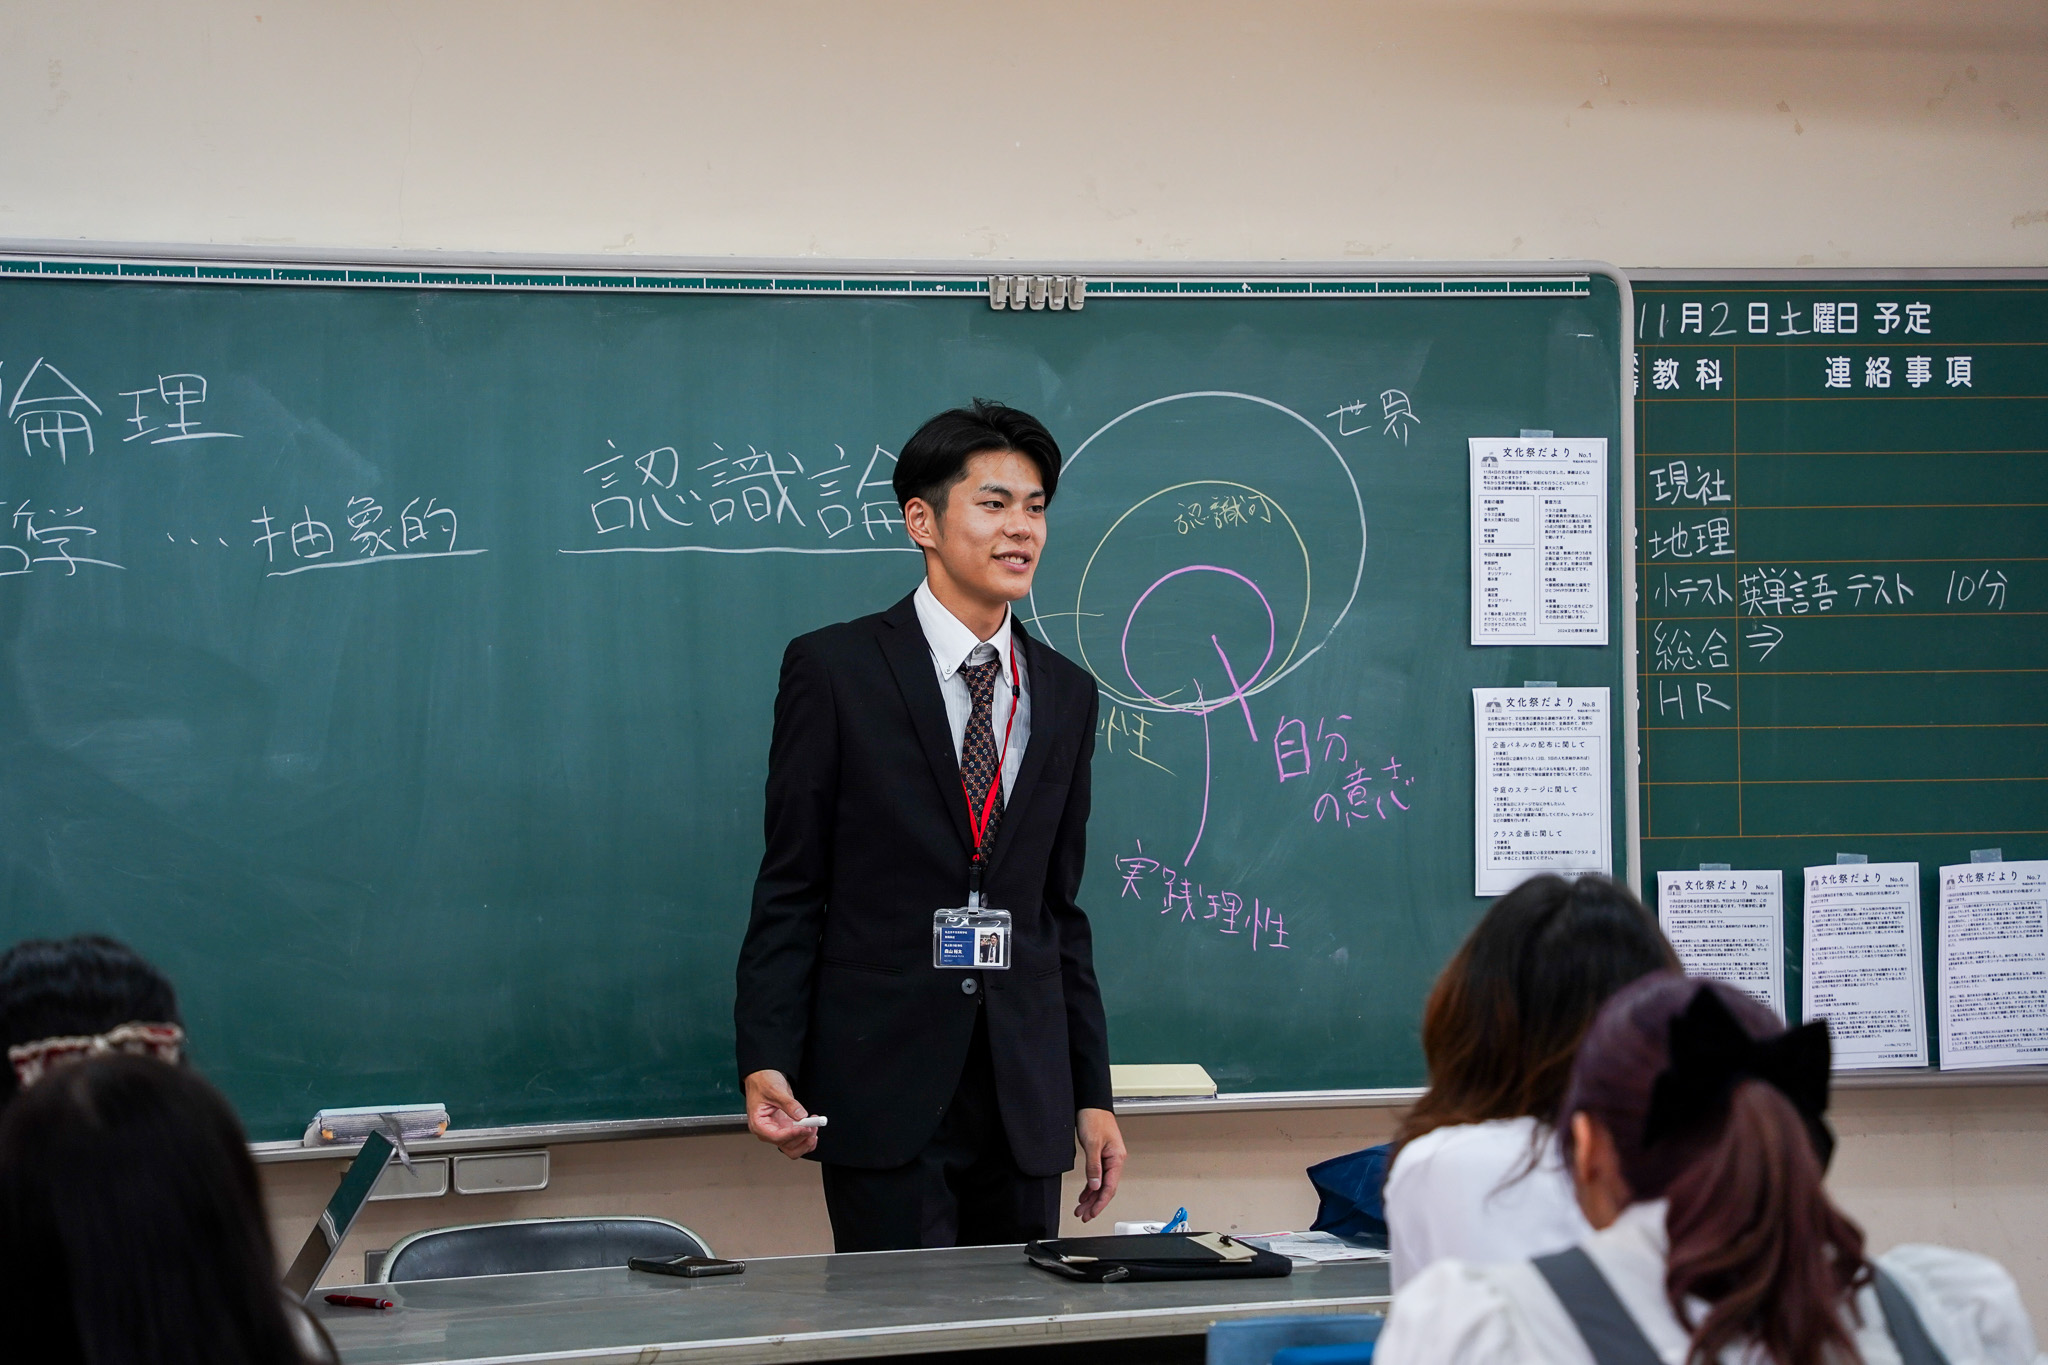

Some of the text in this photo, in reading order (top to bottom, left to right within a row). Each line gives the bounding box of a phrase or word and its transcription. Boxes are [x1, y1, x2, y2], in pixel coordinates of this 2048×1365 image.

[1873, 302, 1931, 334] 予定
[1652, 357, 1723, 391] 教科
[1825, 355, 1973, 389] 連絡事項
[1325, 388, 1421, 447] 世界
[1503, 447, 1570, 458] 文化祭だより
[583, 439, 905, 540] 認識論
[1649, 461, 1731, 505] 現社
[251, 496, 457, 562] 抽象的
[1649, 517, 1735, 558] 地理
[1654, 567, 2008, 616] 小テスト 英単語 テスト 10分
[1654, 621, 1730, 671] 総合
[1506, 697, 1573, 708] 文化祭だより
[1659, 680, 1731, 719] HR
[1274, 714, 1352, 783] 自分
[1115, 839, 1291, 951] 実践理性
[1685, 880, 1748, 890] 文化祭だより
[1821, 873, 1881, 885] 文化祭だより
[1957, 871, 2018, 884] 文化祭だより
